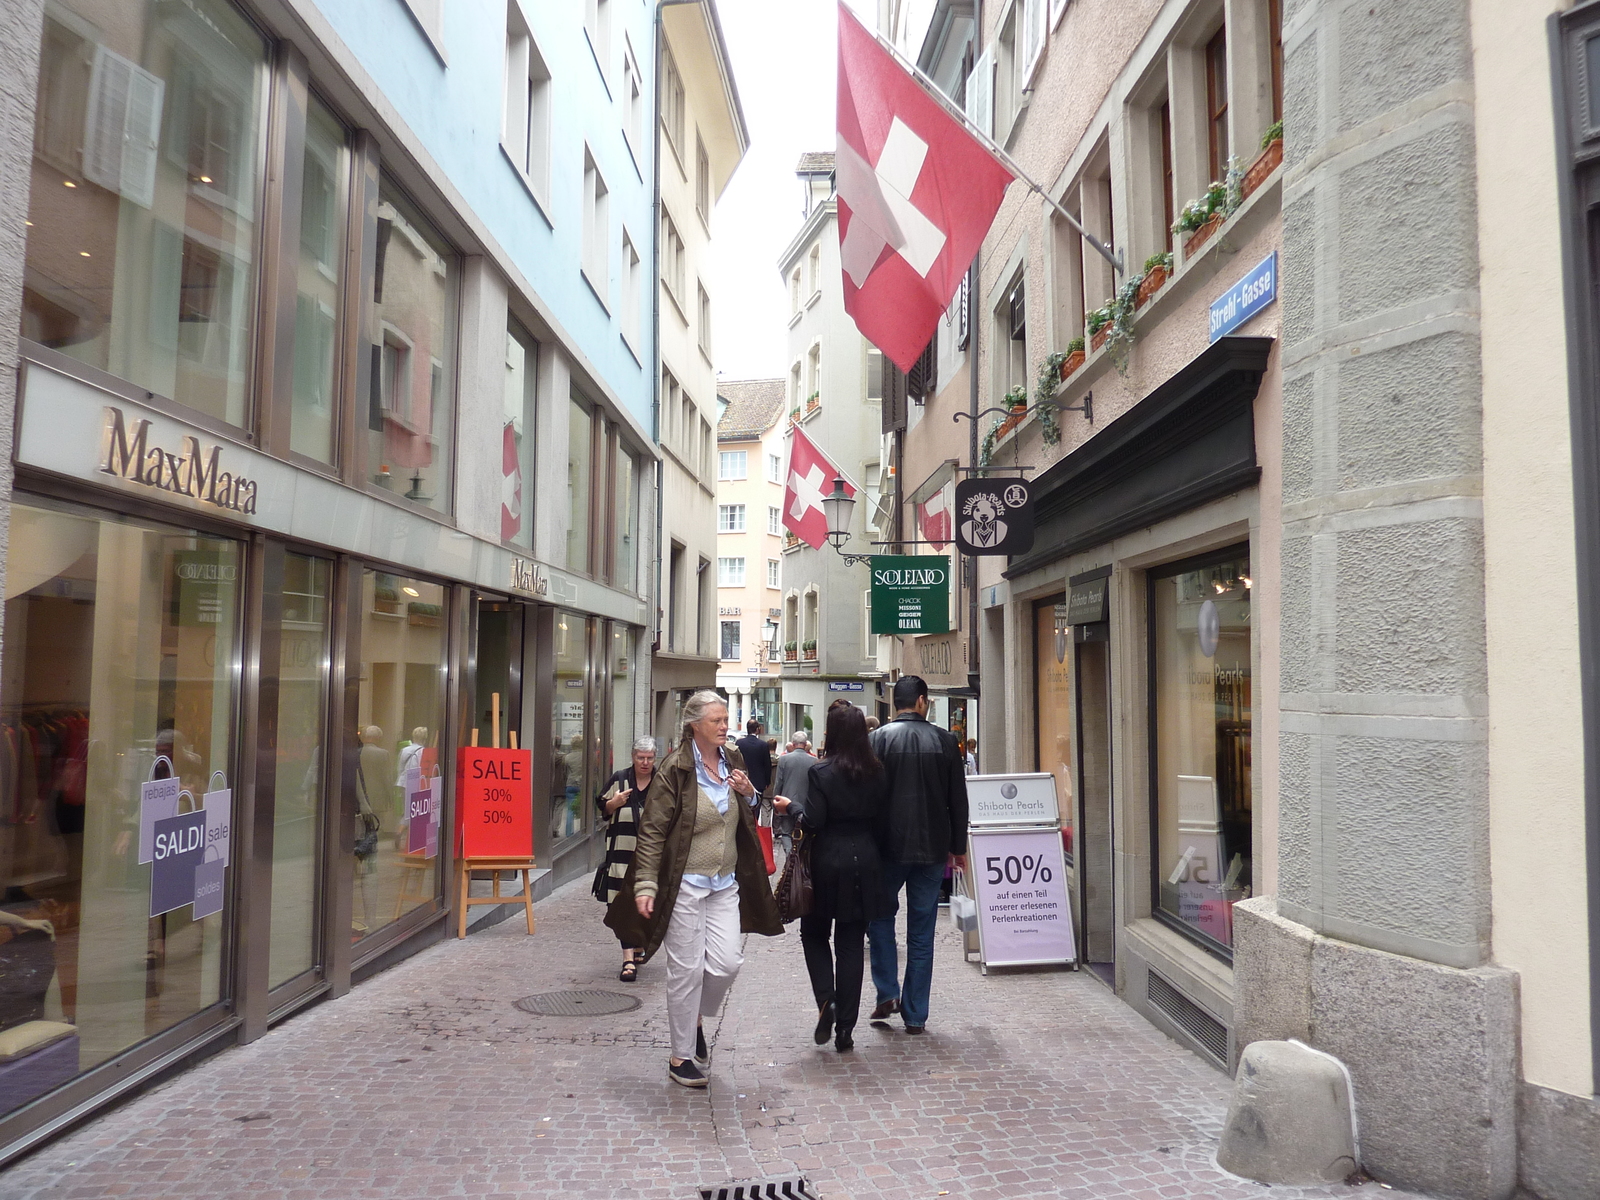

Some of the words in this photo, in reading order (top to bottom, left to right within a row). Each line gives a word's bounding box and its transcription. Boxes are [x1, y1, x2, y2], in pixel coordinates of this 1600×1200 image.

[1211, 271, 1271, 333] Strehl-Gasse
[101, 406, 258, 515] MaxMara
[512, 558, 547, 596] MaxMara
[719, 607, 741, 616] BAR
[898, 619, 922, 629] OLEANA
[1215, 661, 1243, 685] Pearls
[473, 760, 521, 780] SALE
[144, 784, 176, 800] rebajas
[483, 788, 512, 802] 30%
[411, 798, 431, 818] SALDI
[978, 801, 1013, 811] Shibota
[1017, 799, 1044, 810] Pearls
[483, 810, 513, 824] 50%
[155, 824, 204, 860] SALDI
[208, 822, 229, 842] sale
[986, 854, 1053, 885] 50%
[196, 880, 221, 898] soldes
[997, 891, 1009, 900] auf
[1011, 890, 1033, 899] einen
[1034, 889, 1048, 898] Teil
[989, 903, 1018, 912] unserer
[1020, 901, 1058, 911] erlesenen
[992, 912, 1058, 923] Perlenkreationen
